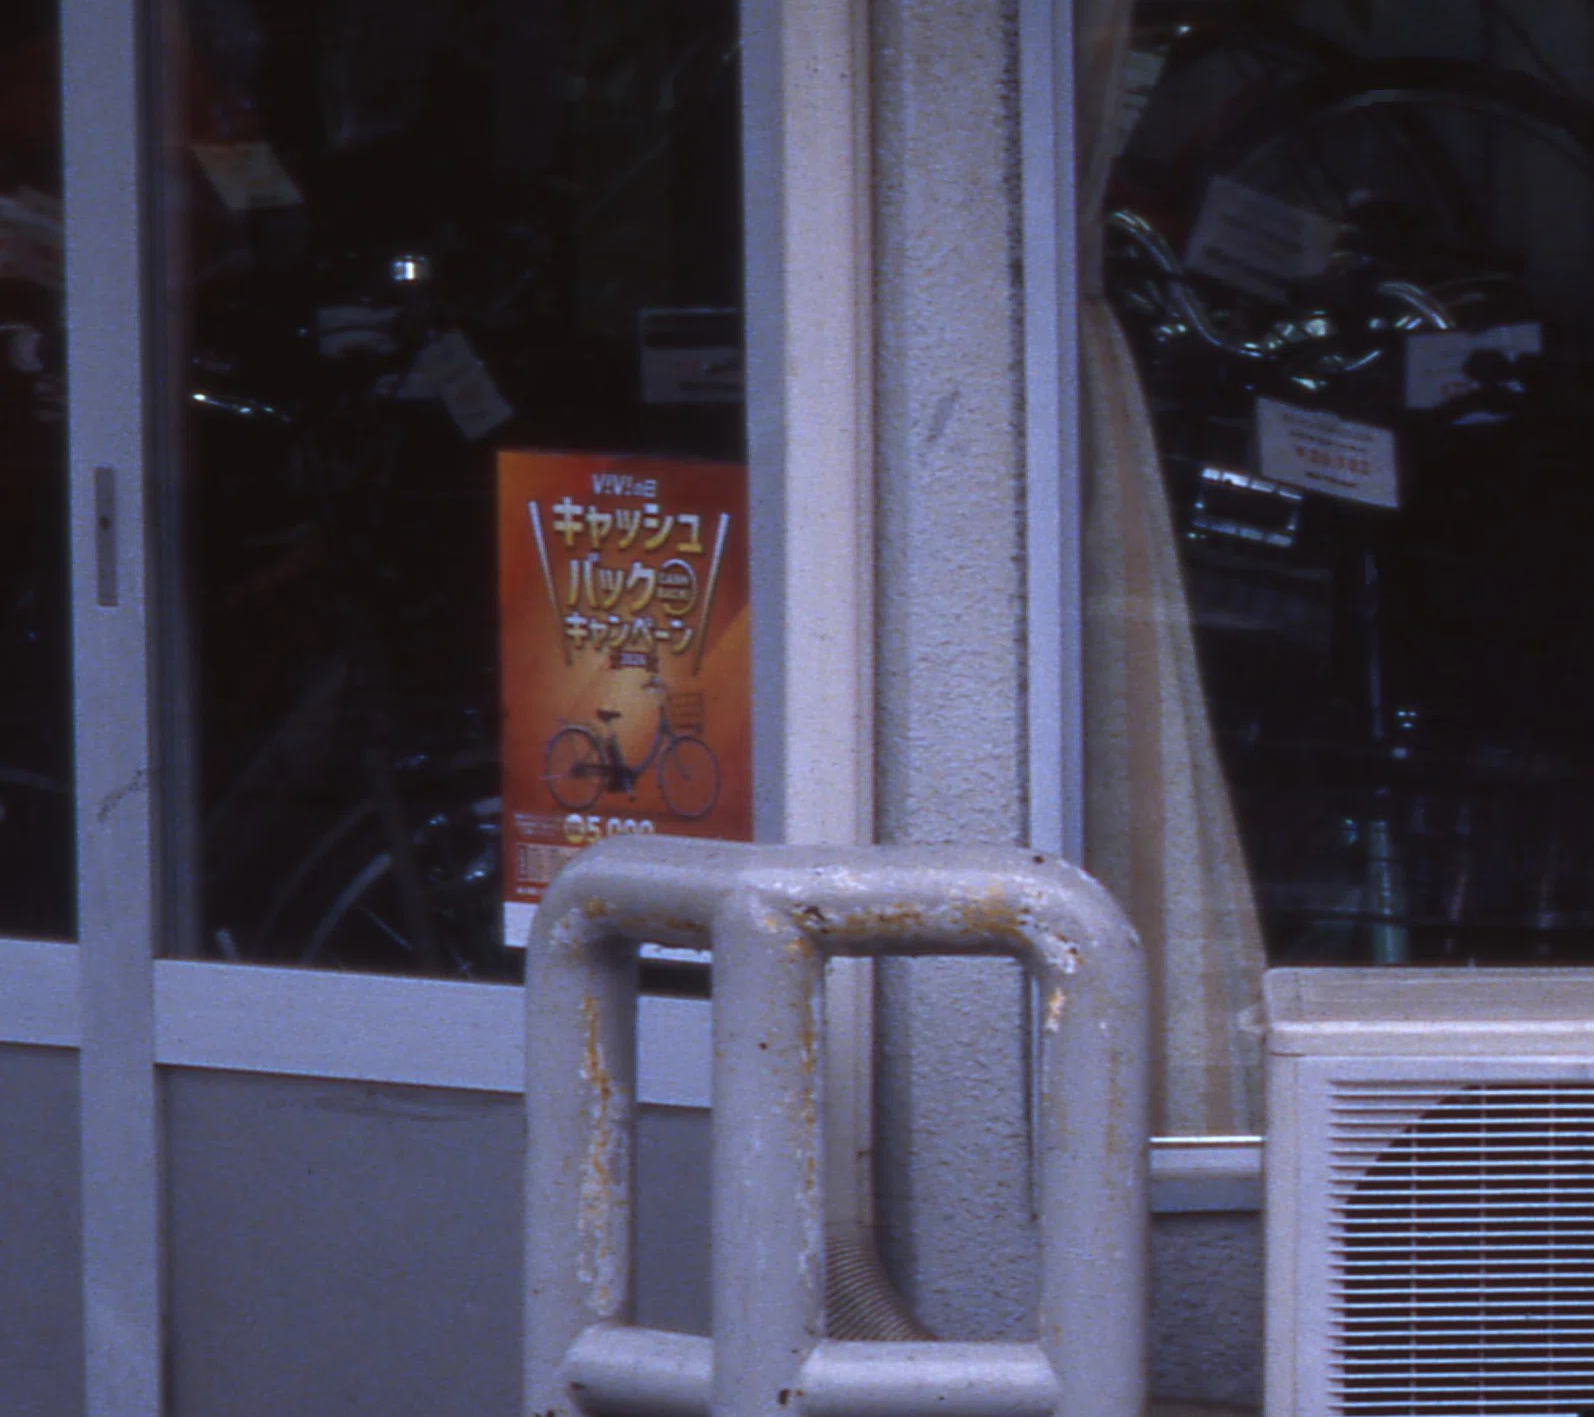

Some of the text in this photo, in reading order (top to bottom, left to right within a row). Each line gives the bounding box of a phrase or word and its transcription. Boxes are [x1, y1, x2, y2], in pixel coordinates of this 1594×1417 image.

[553, 496, 704, 553] キャッシュ
[567, 551, 656, 611] バック
[564, 612, 693, 654] キャンペーン
